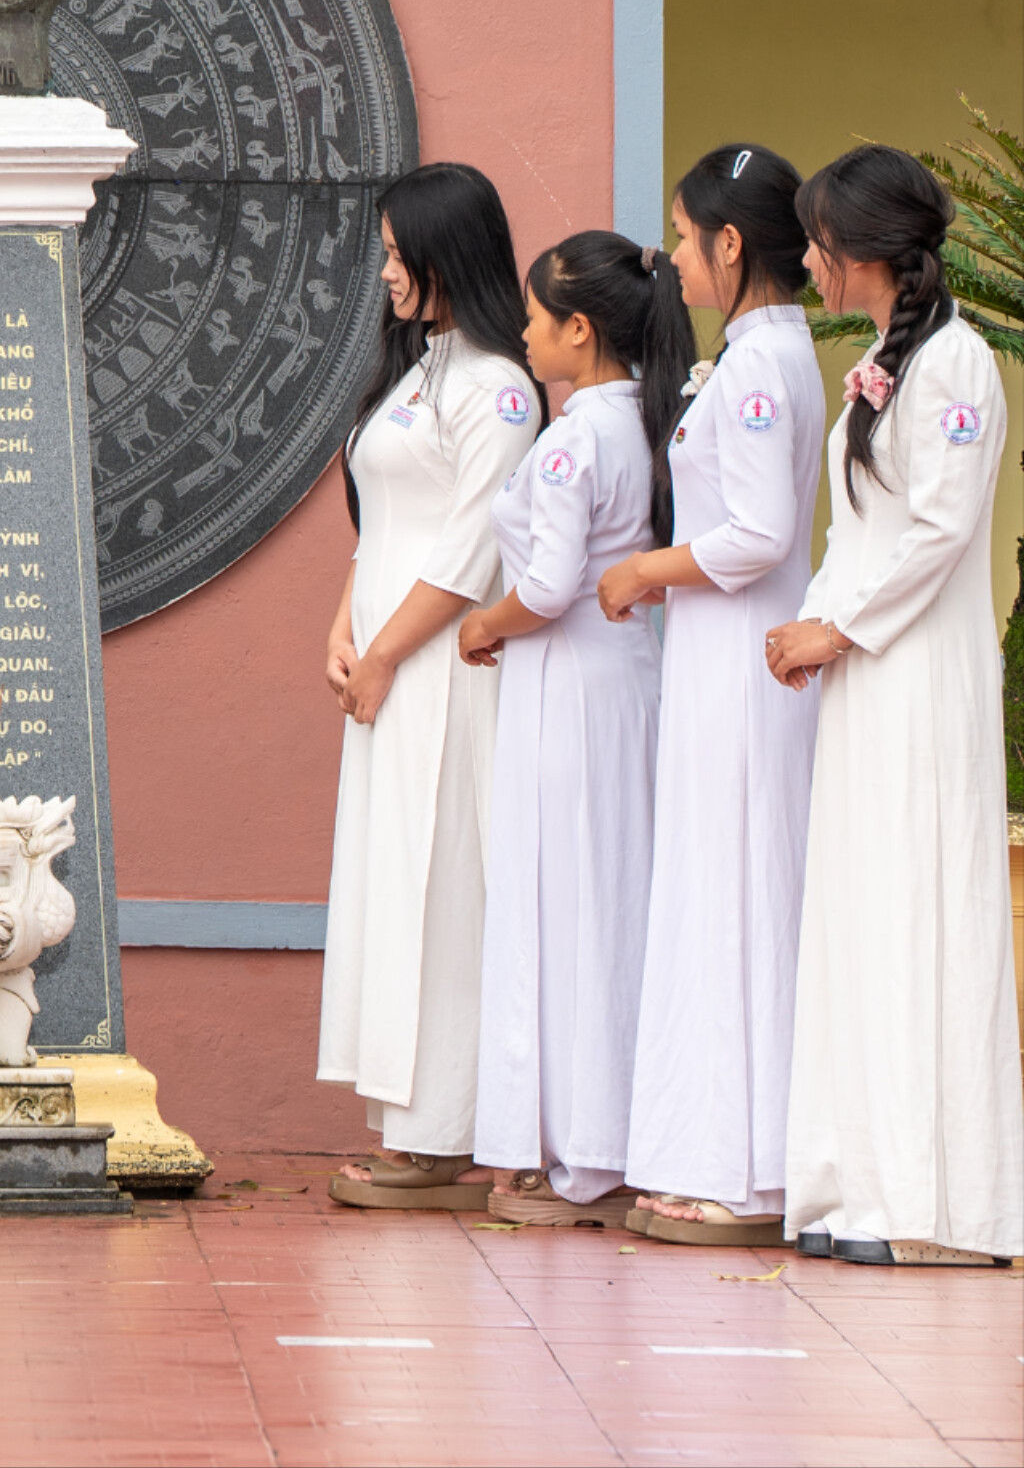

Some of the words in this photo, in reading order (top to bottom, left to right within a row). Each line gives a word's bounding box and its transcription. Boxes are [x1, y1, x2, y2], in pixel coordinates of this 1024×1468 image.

[6, 309, 29, 328] LÀ
[4, 591, 48, 613] LỘC,
[0, 621, 52, 642] GIÀU,
